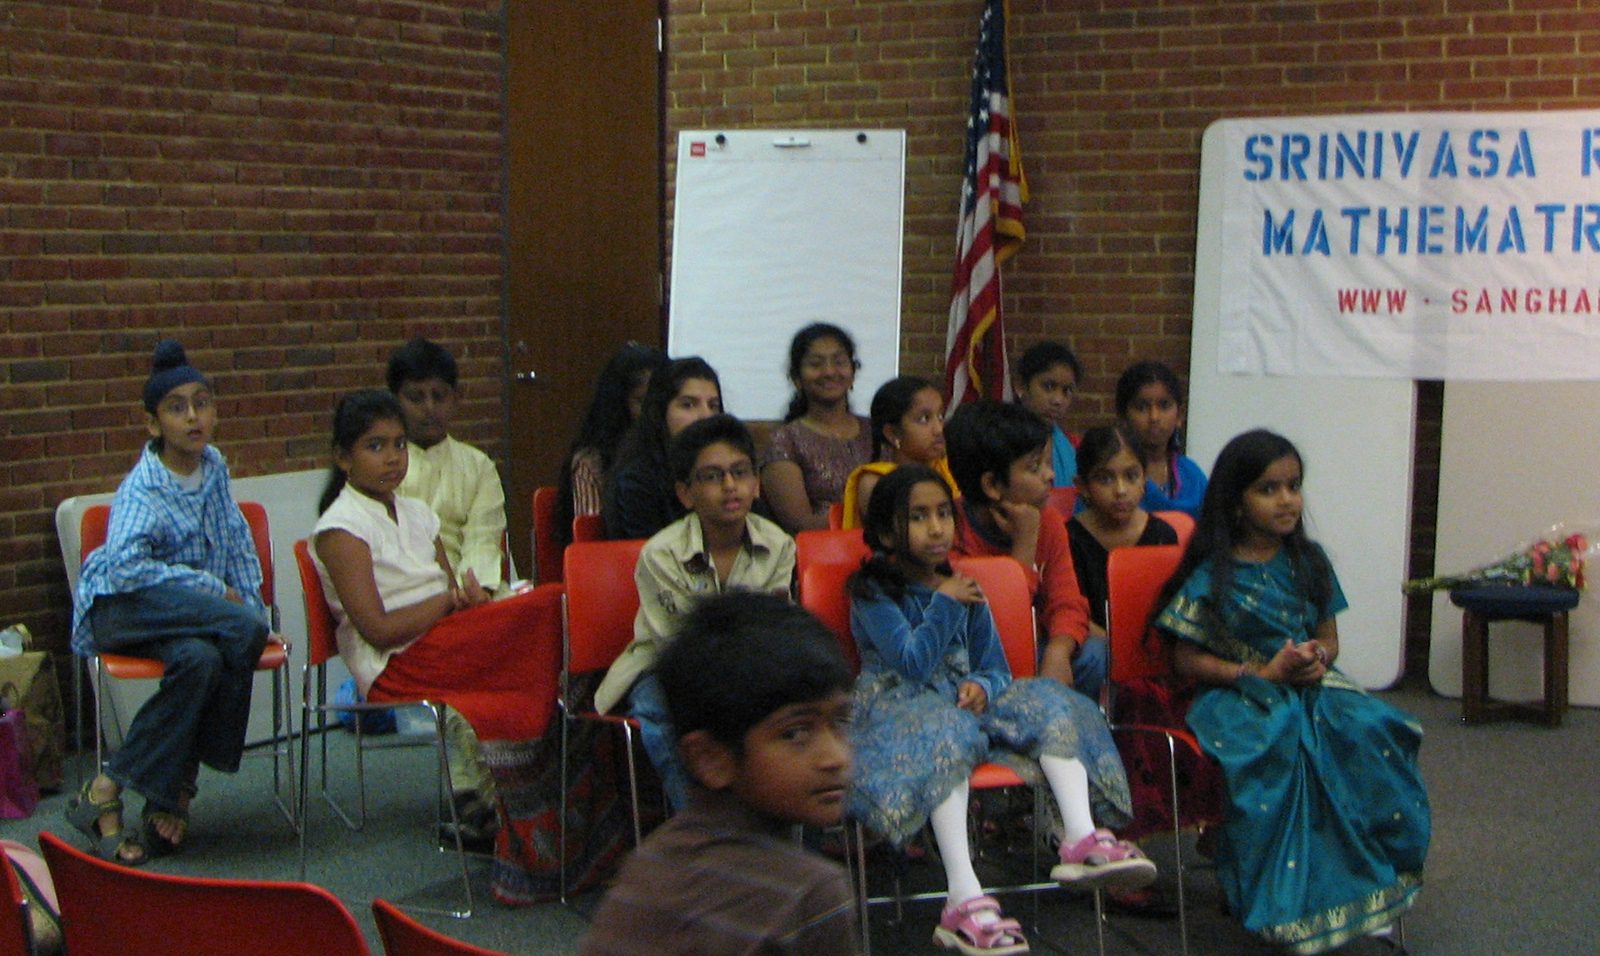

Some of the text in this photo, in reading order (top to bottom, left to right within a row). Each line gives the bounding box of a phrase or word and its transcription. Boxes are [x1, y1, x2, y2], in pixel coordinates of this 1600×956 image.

[1244, 130, 1536, 181] SRINIVASA
[1263, 203, 1600, 256] MATHEMATR
[1452, 288, 1600, 314] SANGHA
